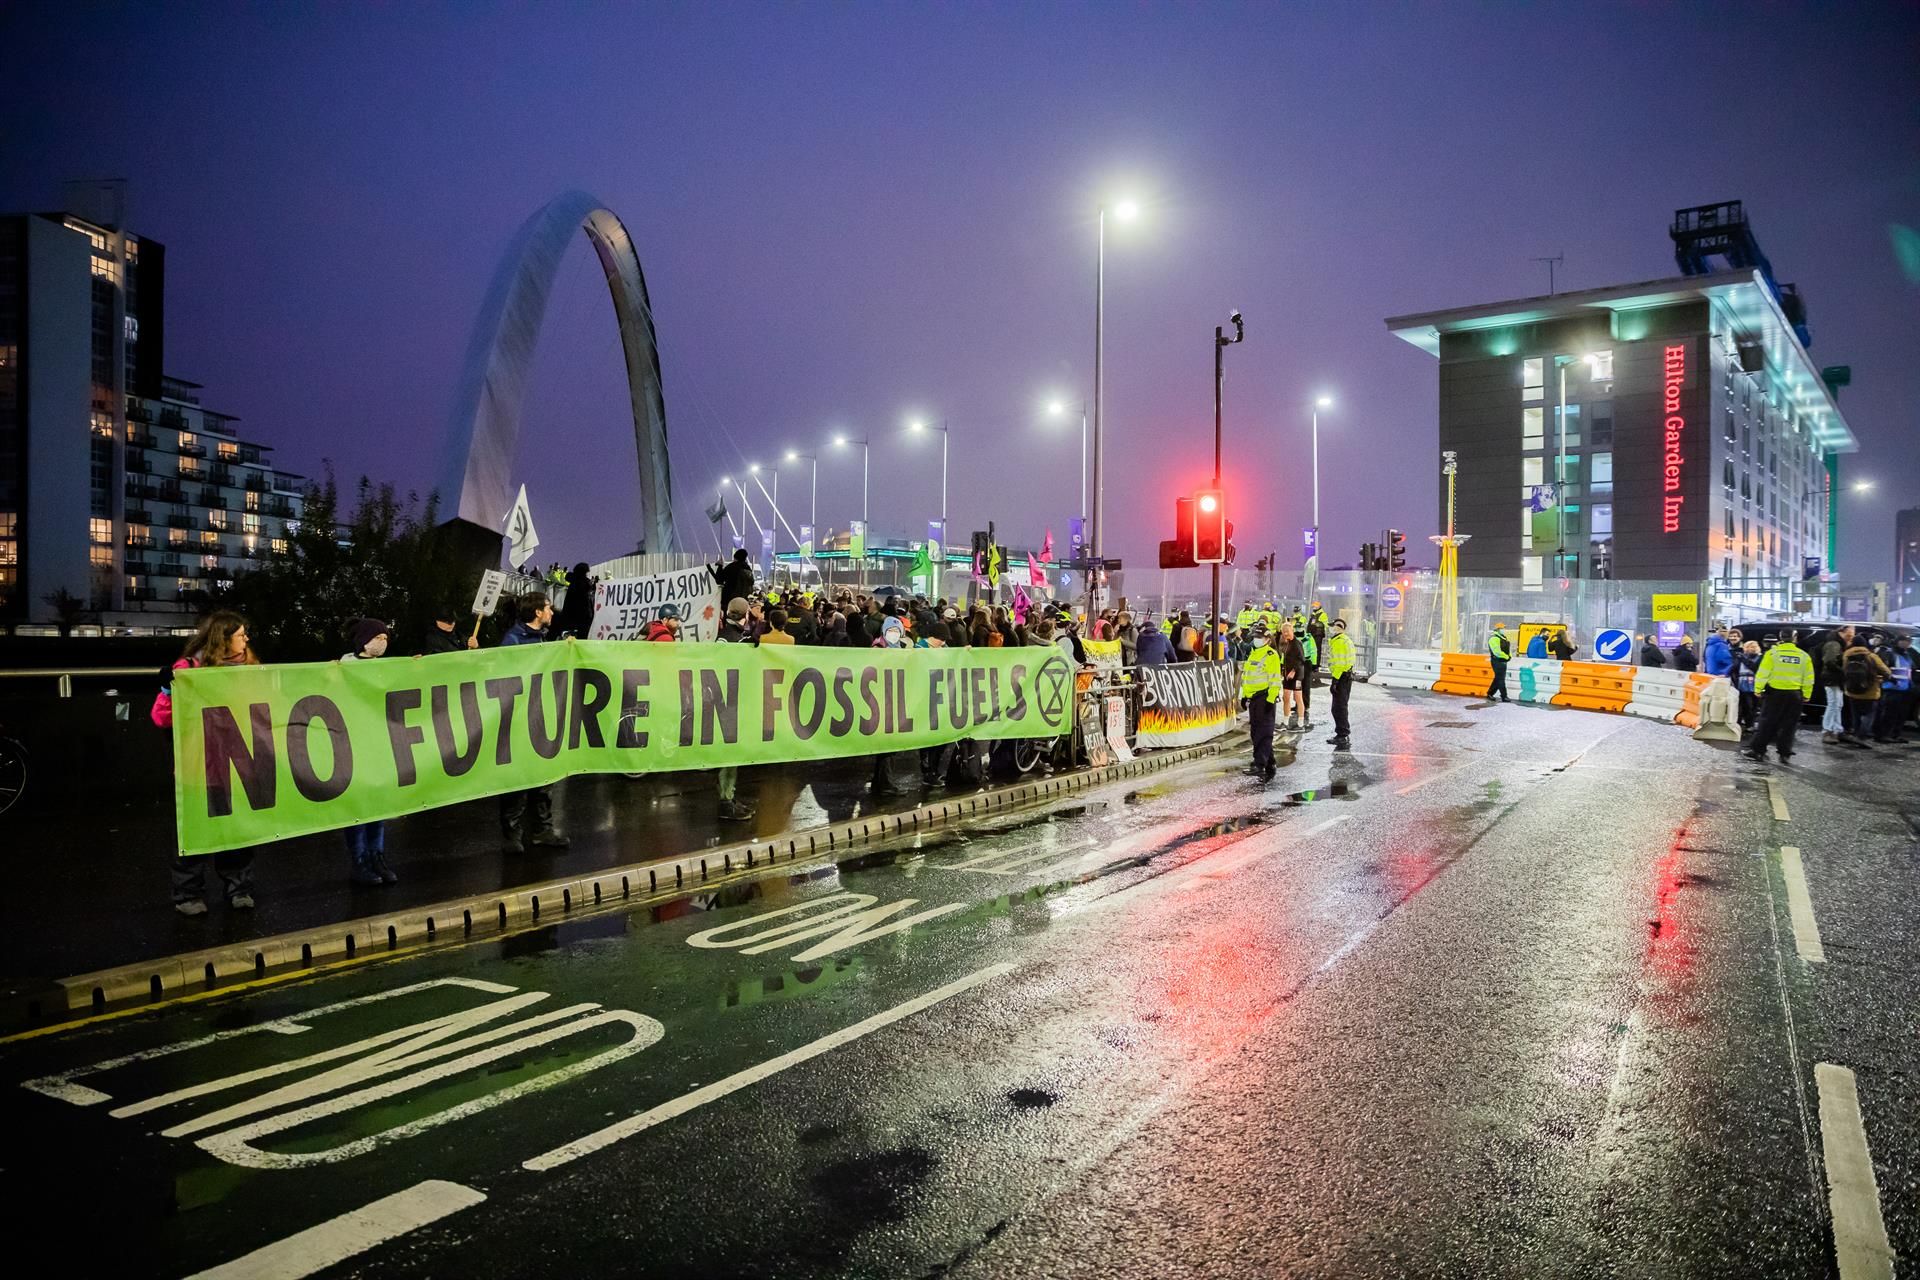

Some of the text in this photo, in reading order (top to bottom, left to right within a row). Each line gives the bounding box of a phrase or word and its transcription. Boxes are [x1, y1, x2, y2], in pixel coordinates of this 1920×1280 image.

[1664, 345, 1684, 533] Hilton Garden Inn
[201, 664, 1027, 818] NO FUTURE IN FOSSIL FUELS
[1201, 658, 1236, 703] EARTH
[685, 892, 970, 963] ON
[21, 976, 666, 1169] END
